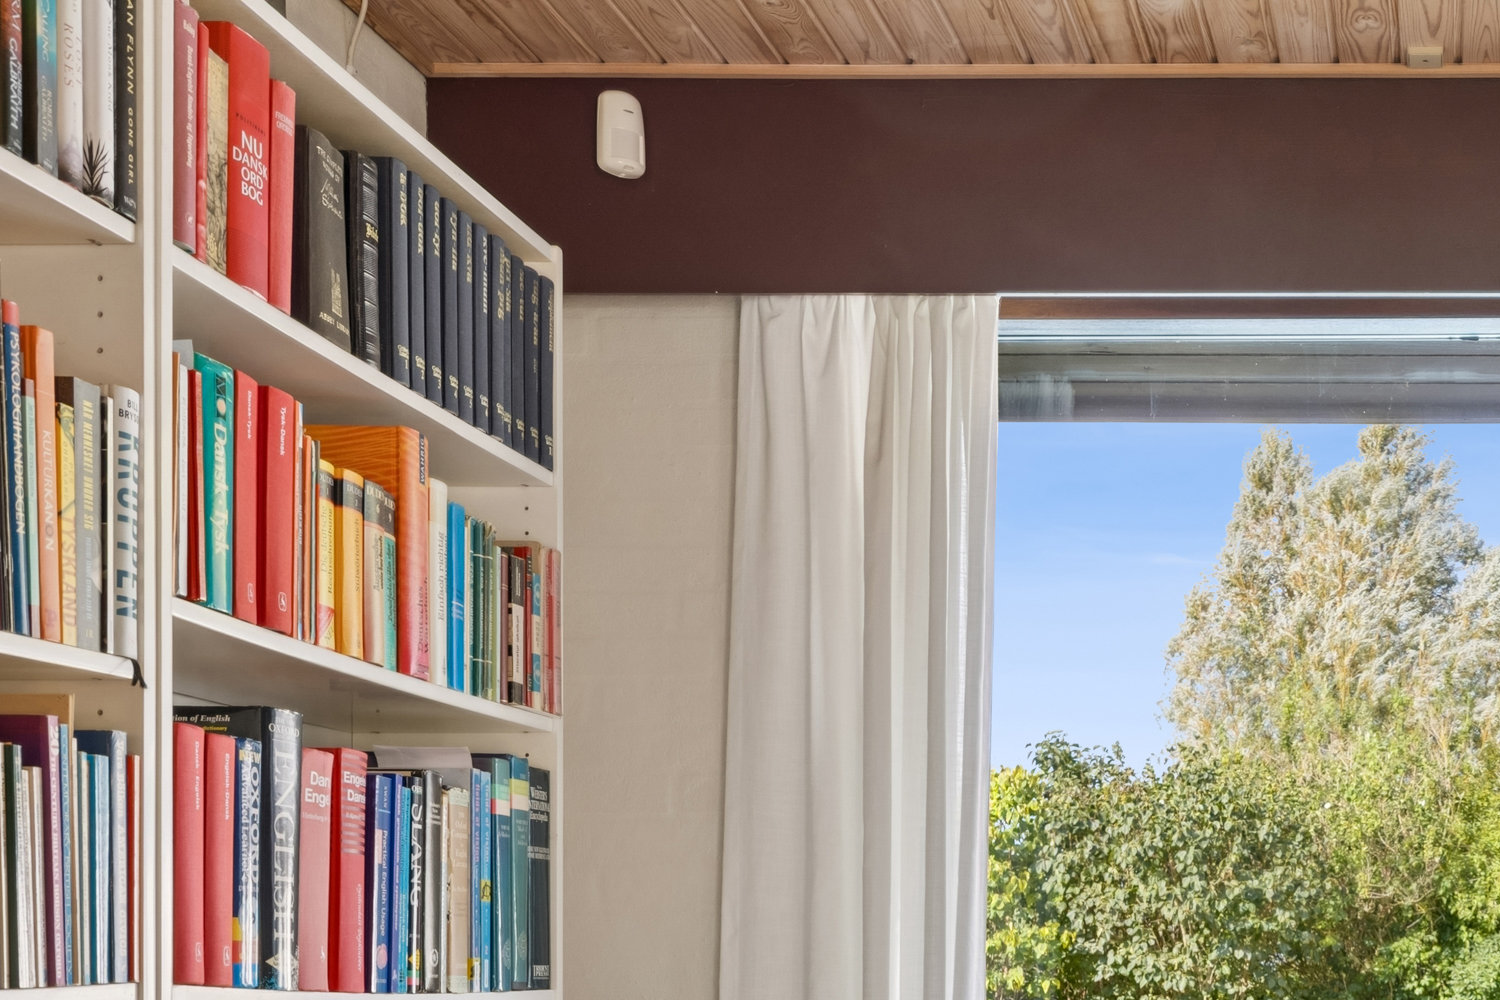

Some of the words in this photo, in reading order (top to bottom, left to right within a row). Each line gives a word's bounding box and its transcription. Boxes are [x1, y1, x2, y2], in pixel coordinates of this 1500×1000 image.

[63, 22, 74, 89] ROSES
[126, 33, 135, 94] FLYNN
[9, 37, 20, 130] GALBRAITH
[126, 107, 134, 147] GONE
[241, 130, 263, 159] NU
[126, 154, 134, 184] GIRL
[232, 145, 268, 180] DANSK
[241, 166, 264, 191] ORD
[241, 182, 264, 206] BOG
[82, 400, 93, 418] NÅR
[10, 331, 25, 534] PSYKOLOGIHANDBOGEN
[82, 421, 94, 472] MENNESKET
[279, 406, 287, 456] Tysk-Dansk
[213, 421, 228, 494] Dansk
[42, 430, 54, 551] KULTURKANON
[83, 476, 95, 511] UNDRER
[84, 514, 95, 531] SIG
[209, 508, 228, 554] Tysk
[436, 531, 446, 573] richtig
[437, 575, 445, 622] Einfach
[200, 715, 231, 724] English
[268, 723, 300, 739] OXFORD
[241, 763, 249, 823] Advanced
[249, 765, 260, 883] OXFORD
[273, 748, 295, 942] ENGLISH
[381, 829, 389, 868] Practical
[410, 803, 424, 907] SLANG
[380, 869, 388, 898] English
[380, 900, 388, 937] Usage
